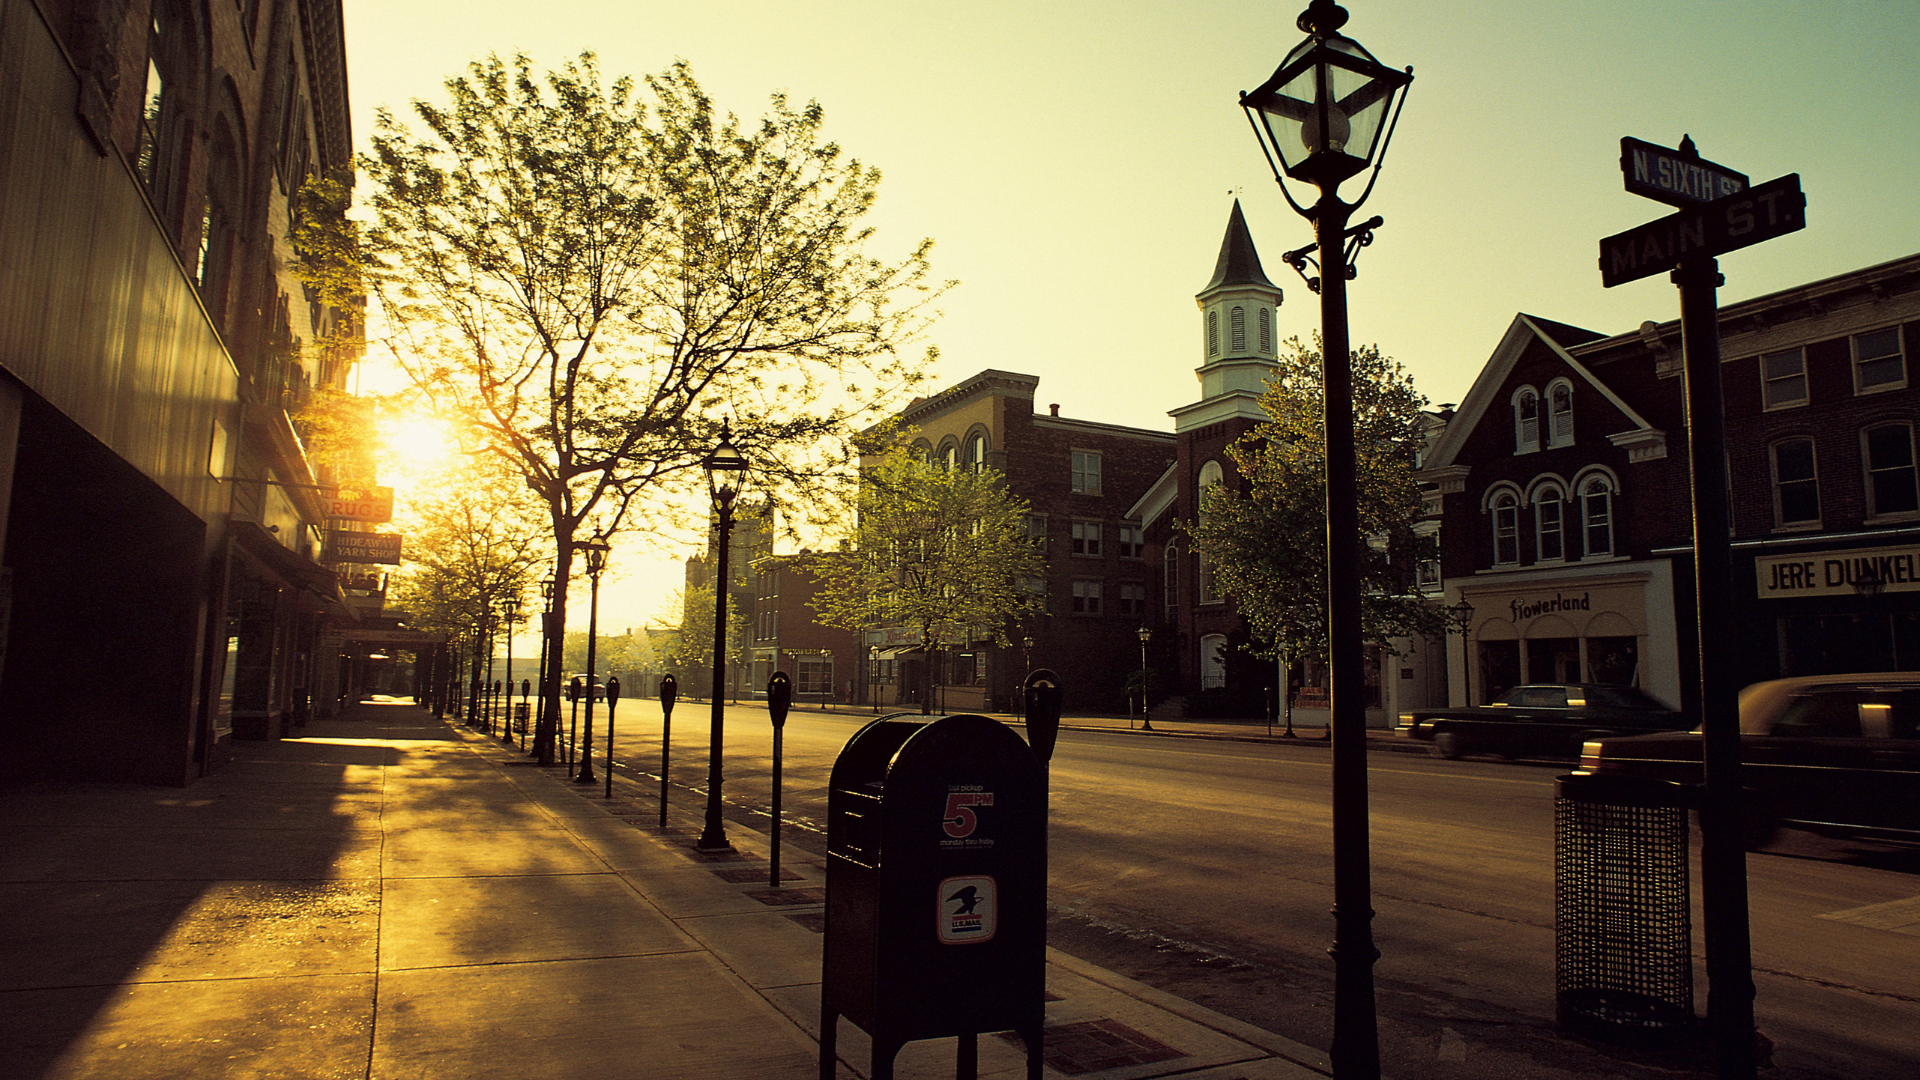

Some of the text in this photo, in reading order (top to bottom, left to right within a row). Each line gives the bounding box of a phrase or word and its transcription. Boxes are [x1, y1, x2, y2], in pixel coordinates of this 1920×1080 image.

[1658, 156, 1713, 201] SIXTH
[1611, 189, 1792, 275] MAIN ST.
[337, 537, 396, 549] HIDEAWAY
[337, 547, 397, 559] YARN SHOP
[1768, 554, 1920, 590] JERE DUNKEL
[961, 784, 983, 793] pickup
[940, 839, 964, 847] monday
[979, 837, 995, 846] friday
